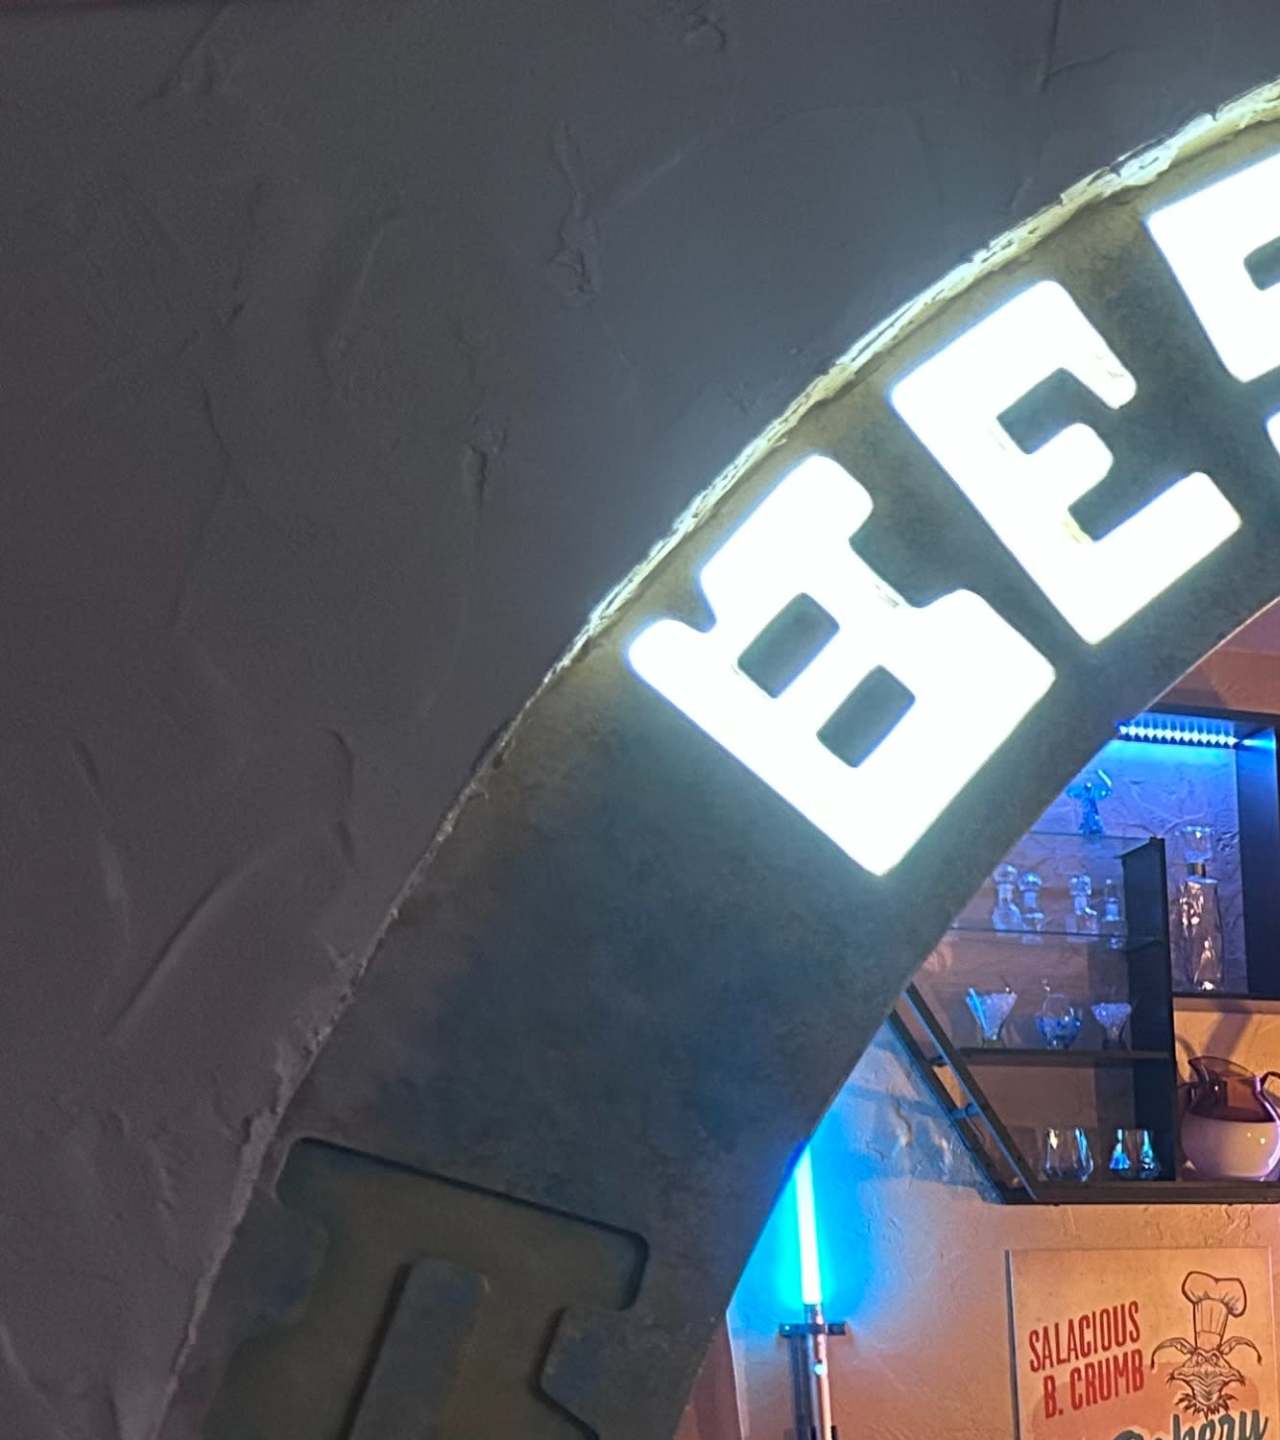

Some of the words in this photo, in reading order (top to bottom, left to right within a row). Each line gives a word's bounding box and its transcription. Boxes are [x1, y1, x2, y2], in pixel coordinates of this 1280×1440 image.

[1028, 1299, 1141, 1373] SALACIOUS
[1043, 1374, 1064, 1419] B.
[1069, 1348, 1145, 1411] CRUMB
